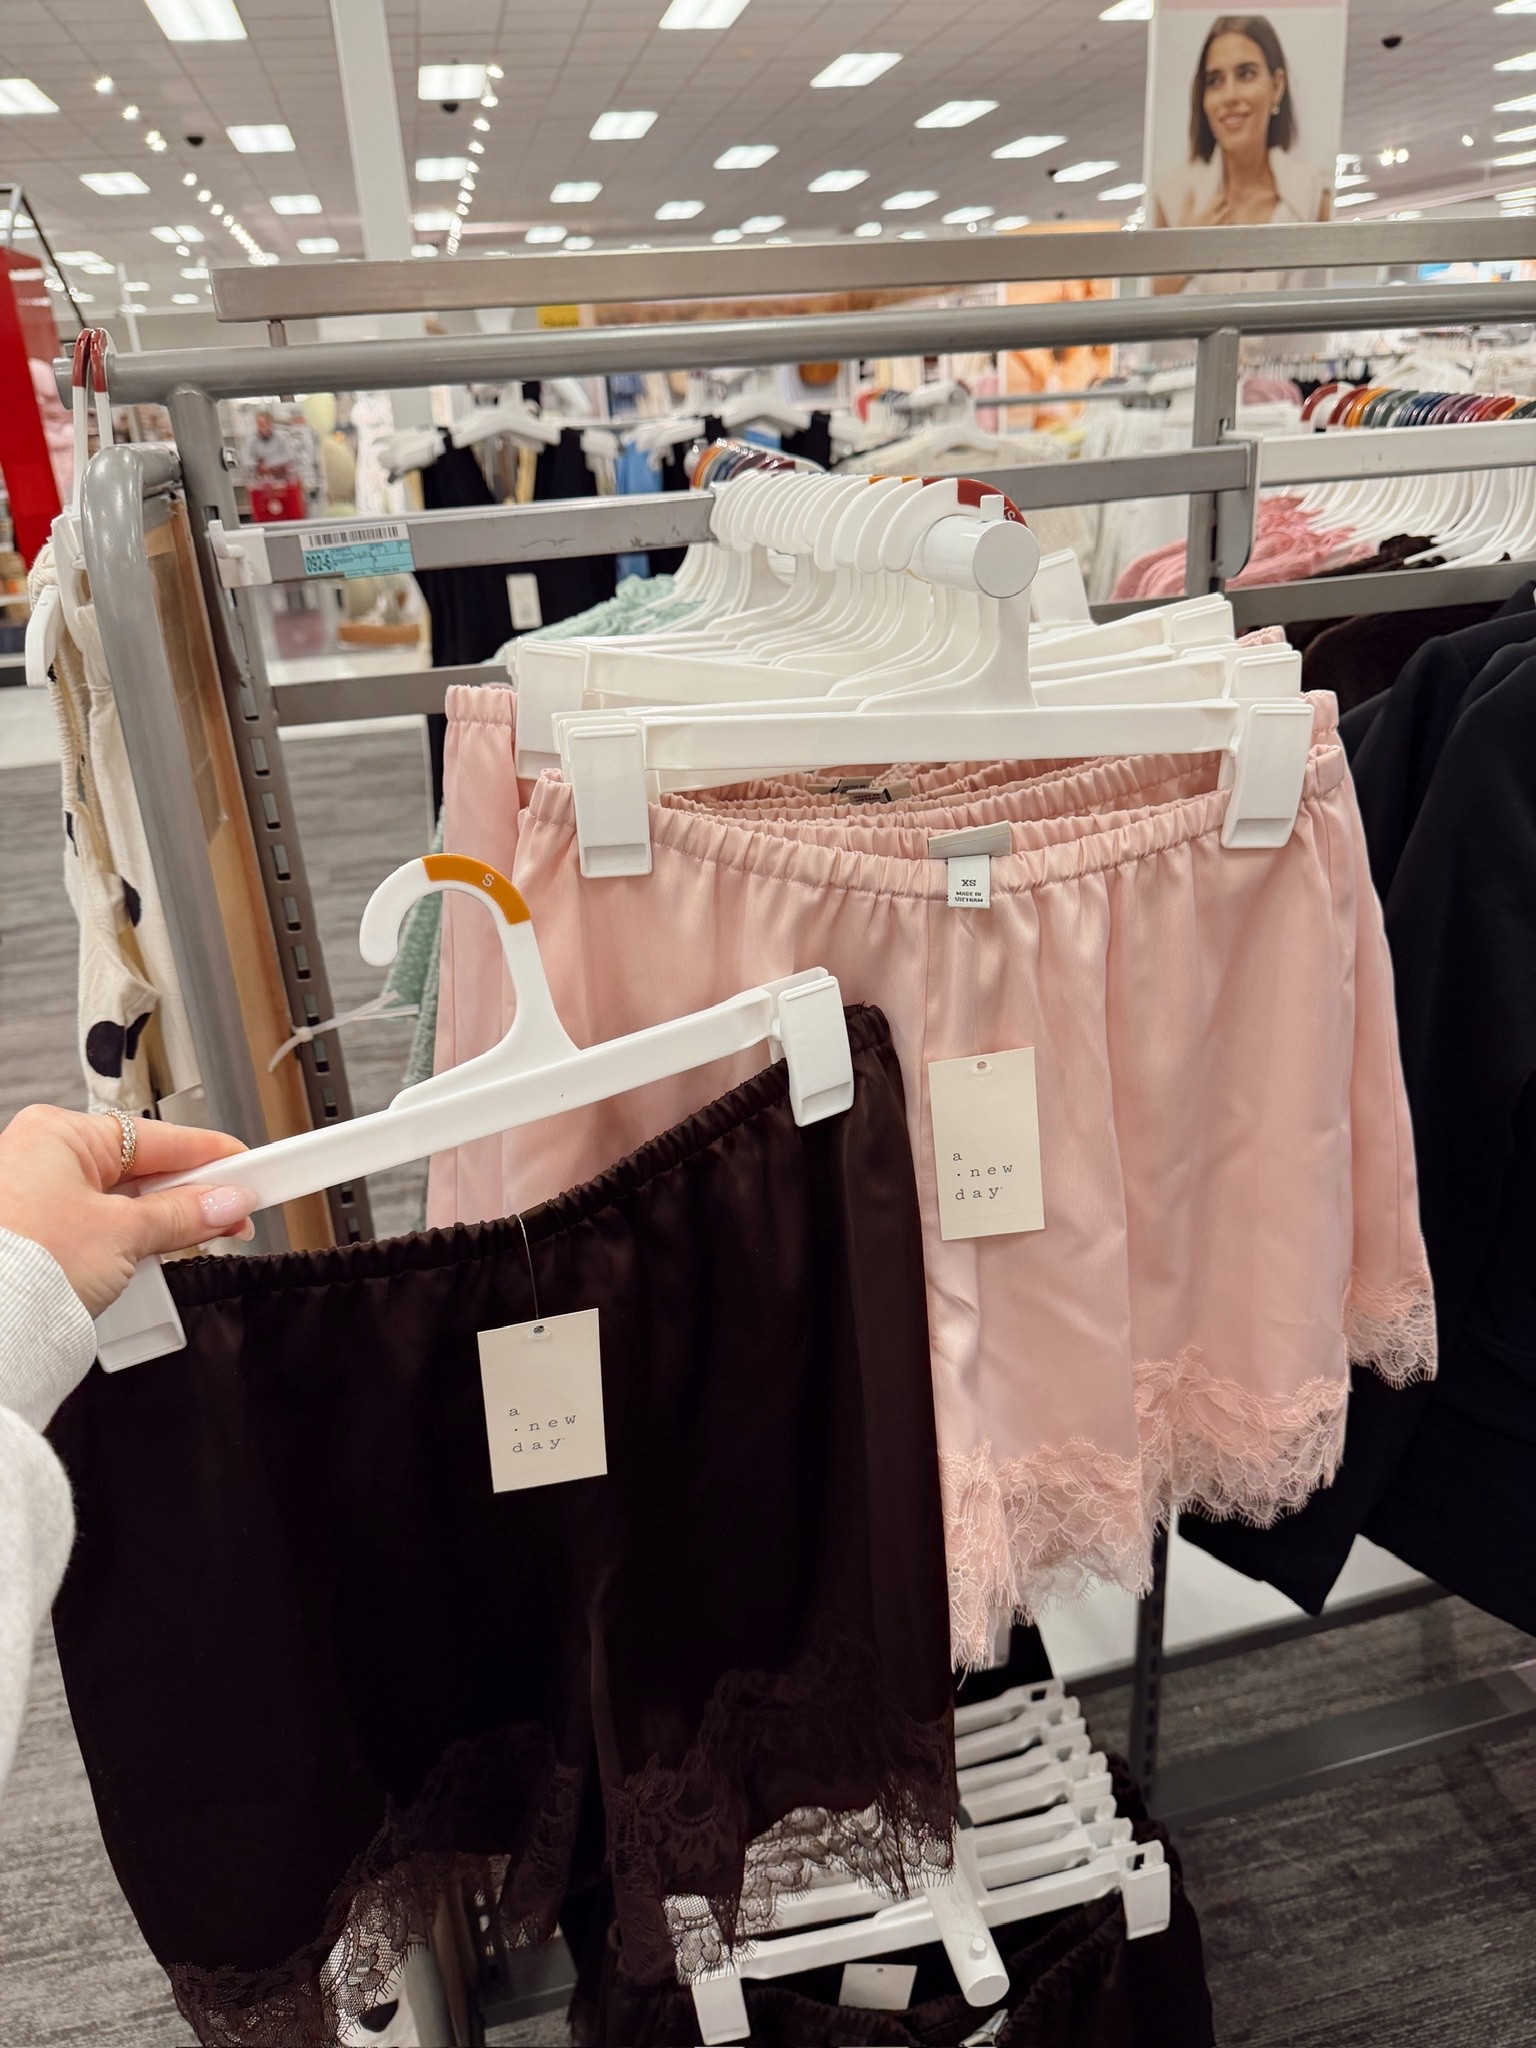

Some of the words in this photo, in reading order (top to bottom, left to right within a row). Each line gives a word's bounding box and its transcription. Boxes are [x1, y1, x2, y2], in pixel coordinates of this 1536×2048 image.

[482, 873, 495, 887] S
[961, 879, 977, 887] XS
[952, 1152, 963, 1162] a
[955, 1186, 1000, 1201] day
[509, 1408, 521, 1417] a
[512, 1438, 562, 1454] day
